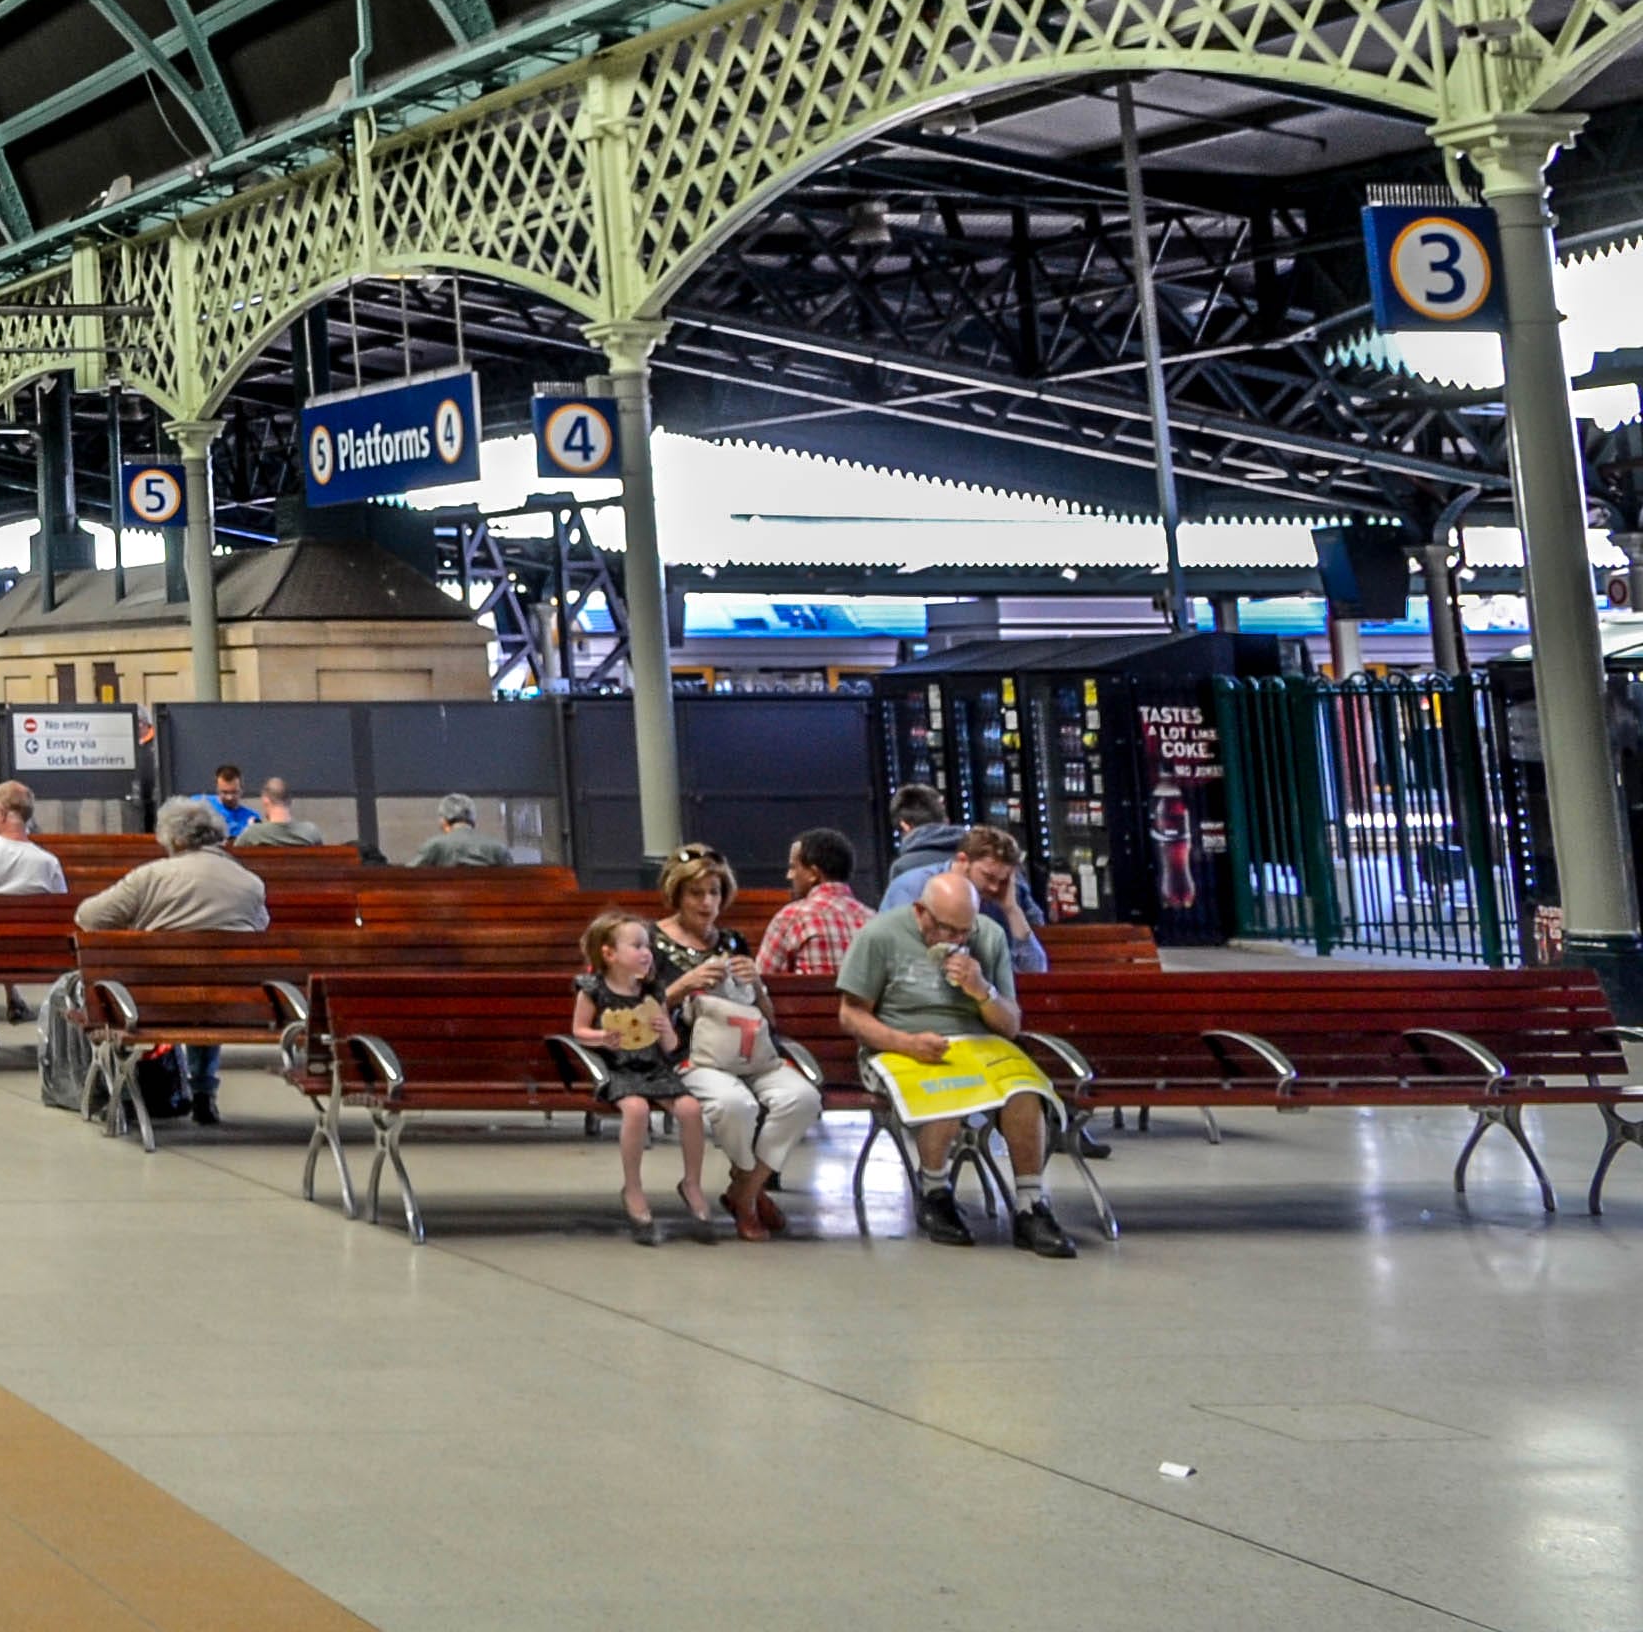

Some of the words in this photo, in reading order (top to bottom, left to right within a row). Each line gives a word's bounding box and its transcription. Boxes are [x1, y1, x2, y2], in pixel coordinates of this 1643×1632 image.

[1420, 233, 1467, 303] 3
[316, 437, 327, 471] 5
[337, 422, 431, 472] Platforms
[444, 413, 455, 449] 4
[563, 416, 595, 461] 4
[145, 479, 166, 513] 5
[1137, 706, 1203, 724] TASTES
[45, 720, 59, 729] No
[62, 720, 90, 732] entry
[1160, 726, 1186, 740] LOT
[46, 738, 76, 751] Entry
[80, 739, 96, 749] via
[47, 755, 78, 765] ticket
[82, 754, 125, 765] barriers
